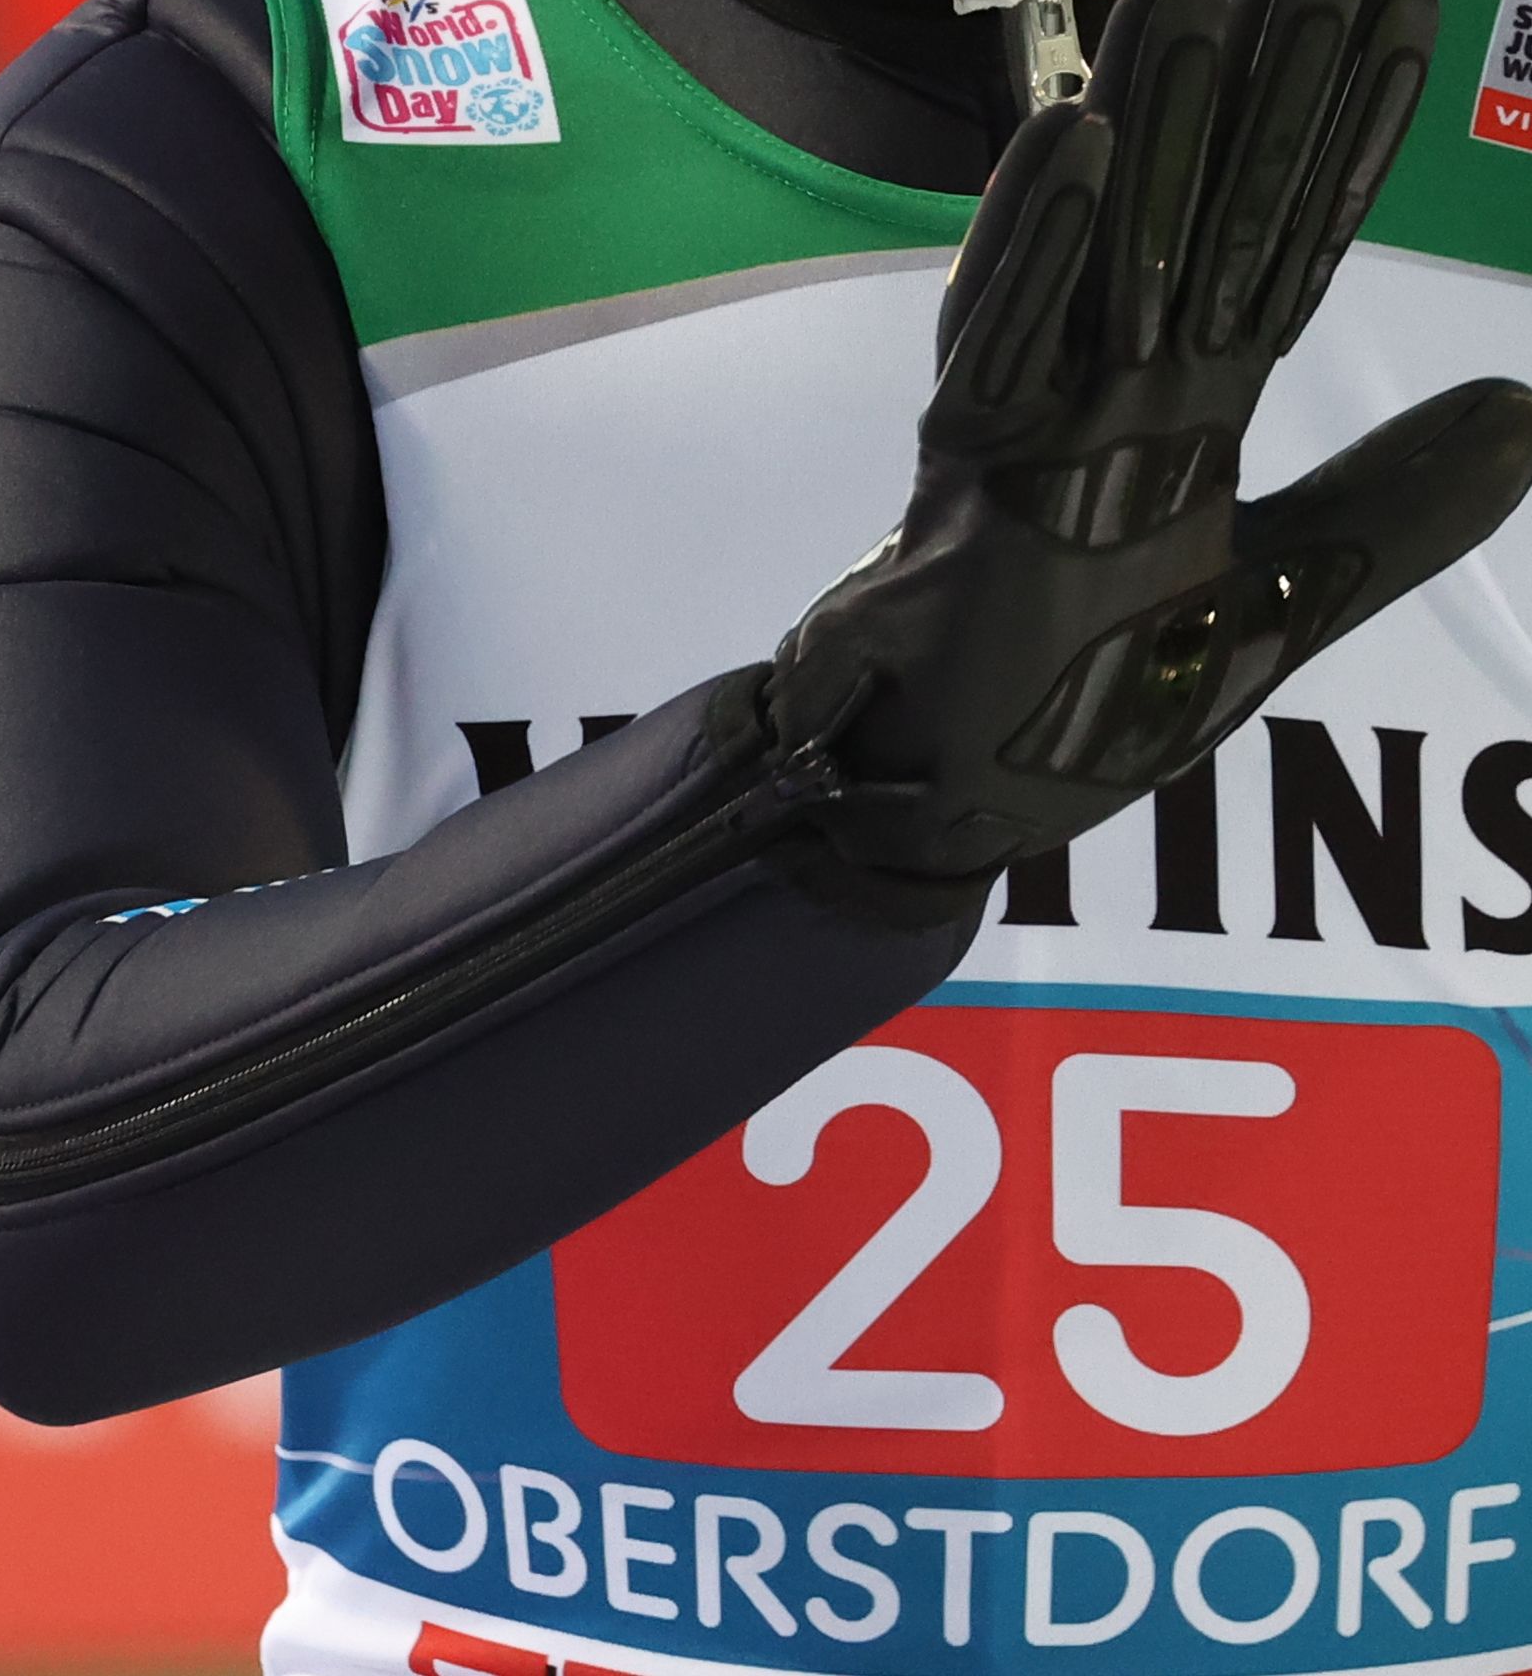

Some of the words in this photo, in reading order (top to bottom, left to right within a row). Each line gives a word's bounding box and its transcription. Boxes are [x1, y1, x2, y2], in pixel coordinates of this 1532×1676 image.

[345, 25, 513, 87] Snow
[374, 83, 459, 125] Day
[733, 1045, 1312, 1437] 25
[372, 1438, 1521, 1647] OBERSTDORF
